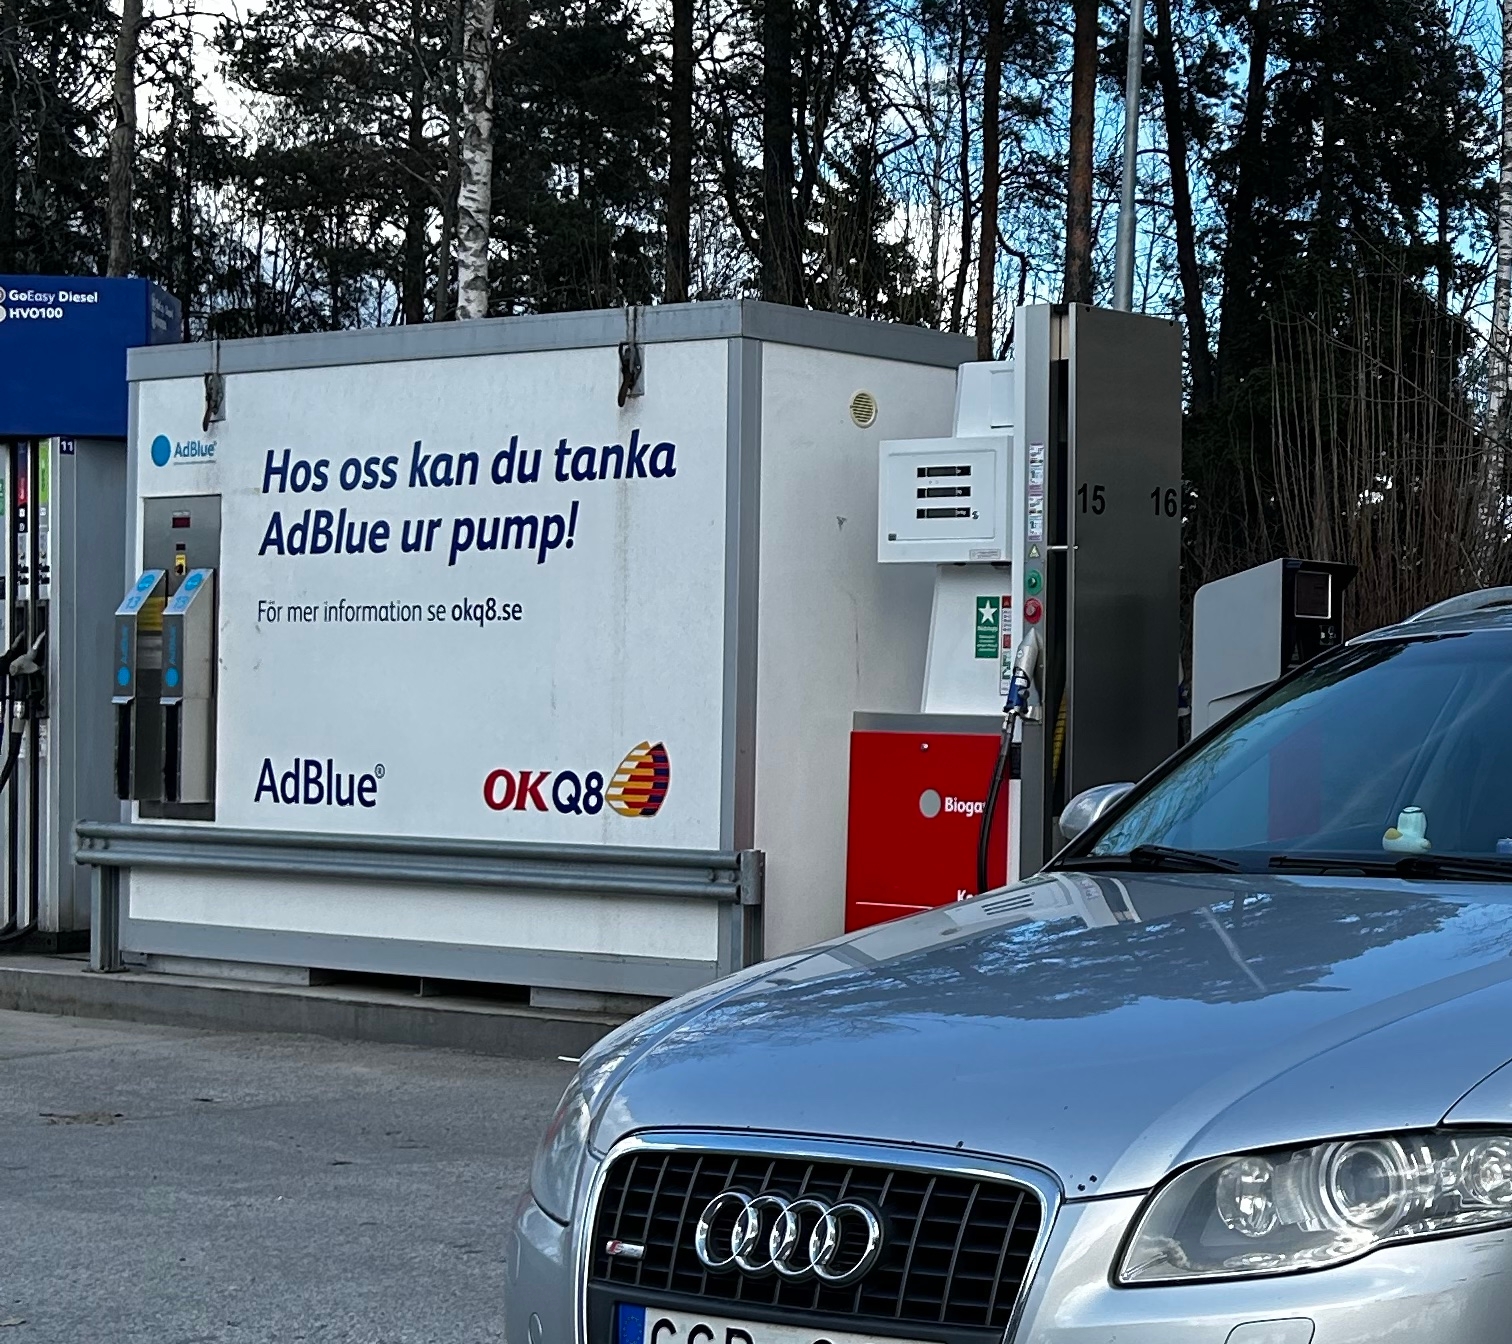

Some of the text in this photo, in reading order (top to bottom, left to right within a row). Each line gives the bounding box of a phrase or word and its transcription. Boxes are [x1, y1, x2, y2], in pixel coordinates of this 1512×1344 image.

[9, 290, 98, 304] GoEasy Diesel
[9, 307, 63, 319] HVO100
[61, 441, 74, 452] 11
[262, 429, 677, 493] Hos oss kan du tanka
[1078, 482, 1105, 515] 15
[1150, 486, 1177, 517] 16
[258, 500, 579, 566] AdBlue ur pump!
[258, 597, 523, 627] För mer information se okq8.se
[483, 768, 604, 816] OKQ8
